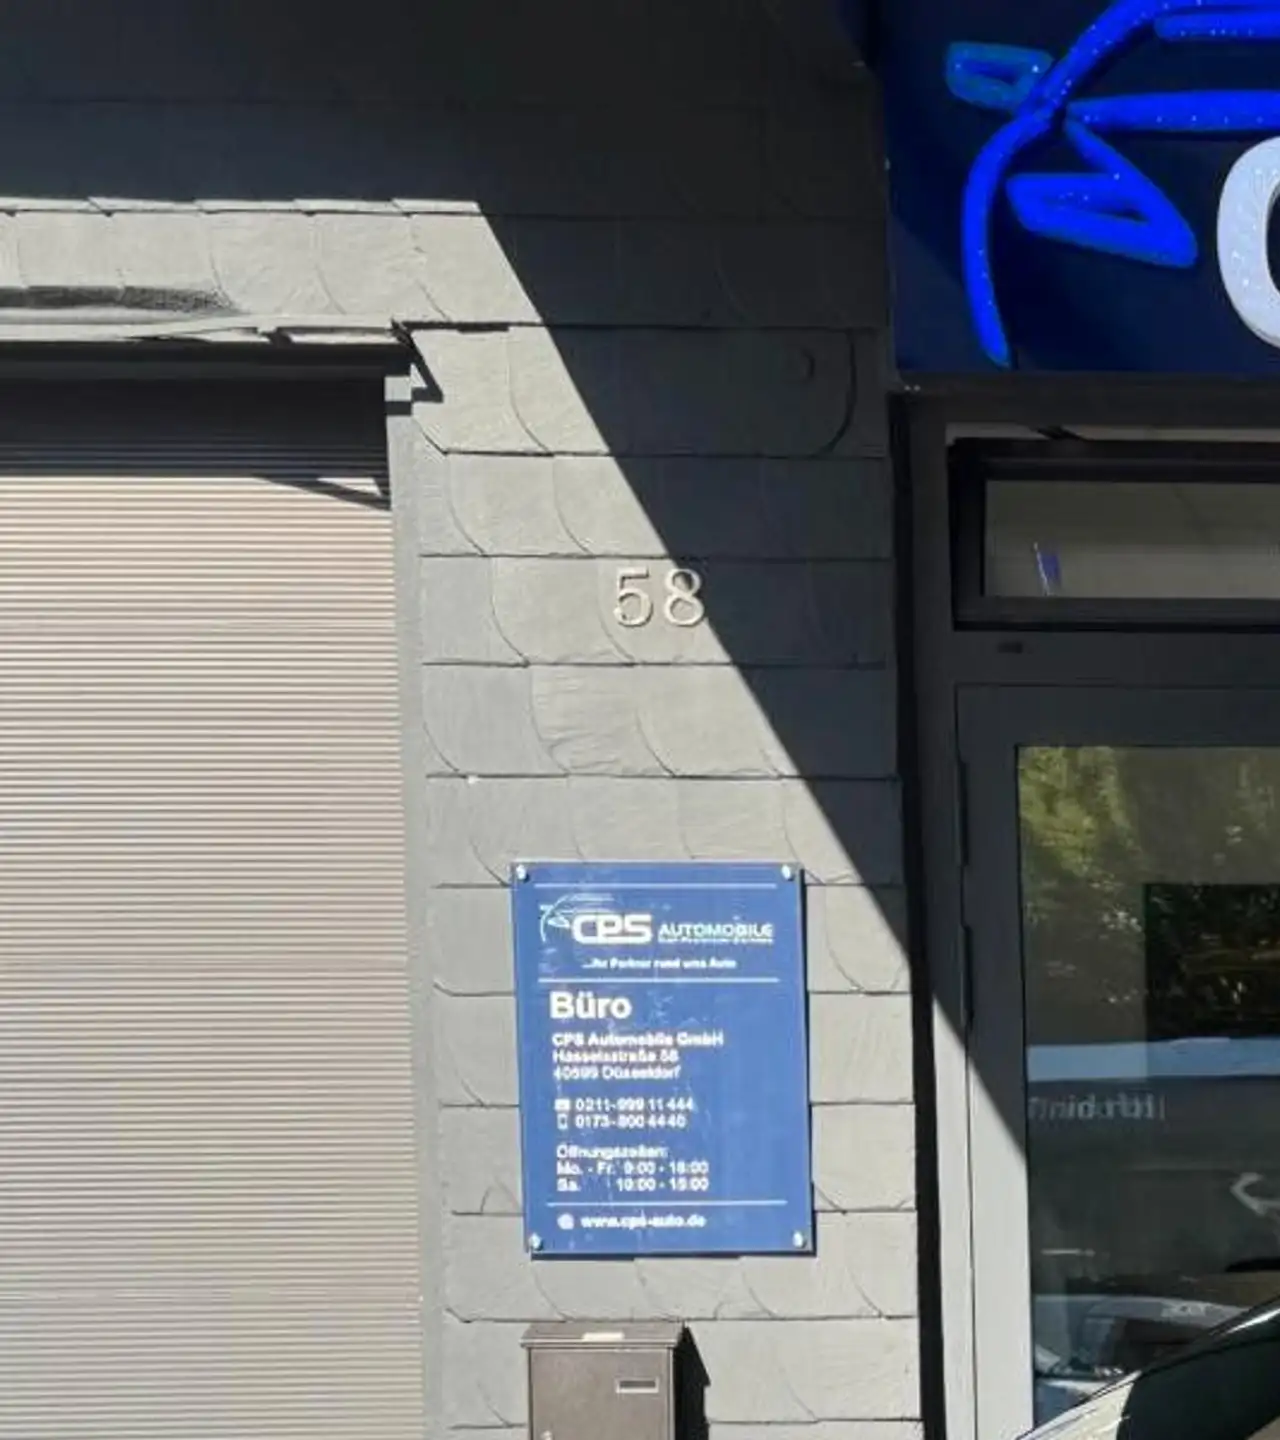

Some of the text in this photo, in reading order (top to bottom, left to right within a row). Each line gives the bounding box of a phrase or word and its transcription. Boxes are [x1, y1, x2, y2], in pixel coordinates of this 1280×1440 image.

[613, 566, 705, 627] 58
[571, 913, 774, 945] CPS AUTOMOBILE
[549, 990, 633, 1019] Büro
[551, 1030, 725, 1047] CPS Automobile GmbH
[601, 1064, 682, 1080] Düsseldorf
